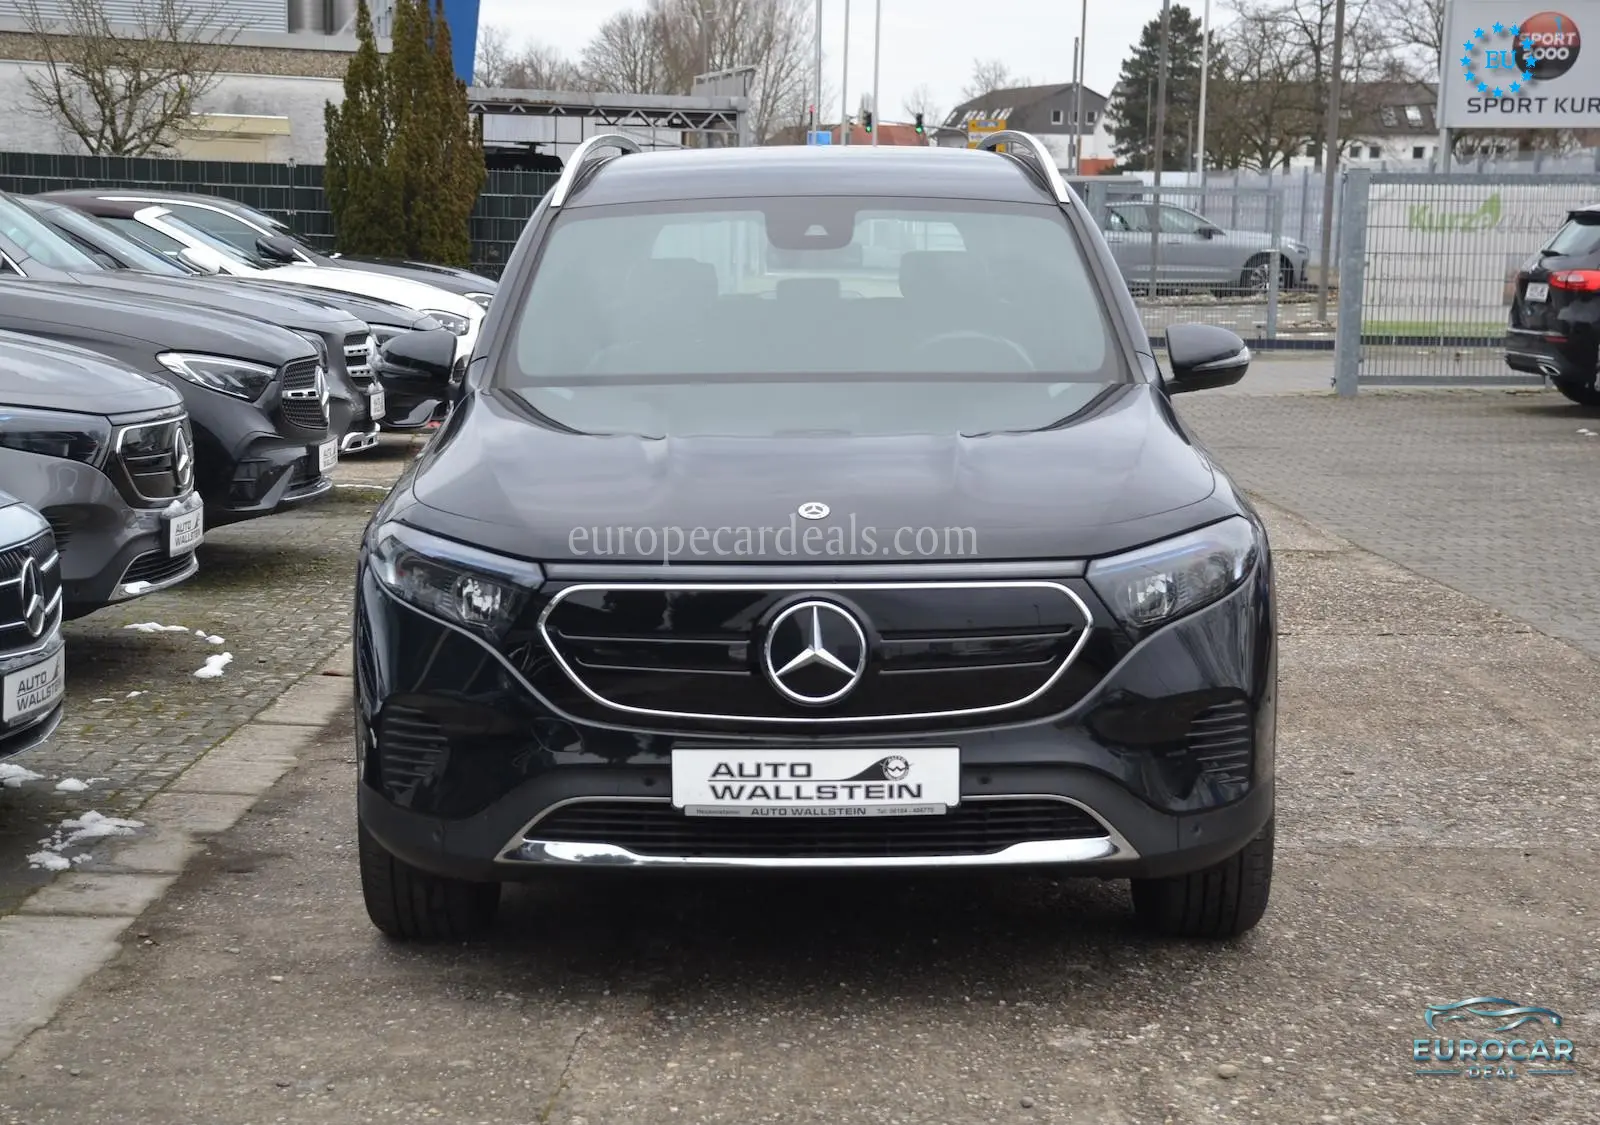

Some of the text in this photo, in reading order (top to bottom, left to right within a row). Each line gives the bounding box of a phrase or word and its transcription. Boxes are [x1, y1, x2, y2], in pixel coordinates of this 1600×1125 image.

[1467, 97, 1548, 113] SPORT
[18, 671, 47, 694] AUTO
[711, 762, 812, 778] AUTO
[709, 783, 923, 801] WALLSTEIN
[751, 807, 788, 817] AUTO
[791, 807, 867, 817] WALLSTEIN
